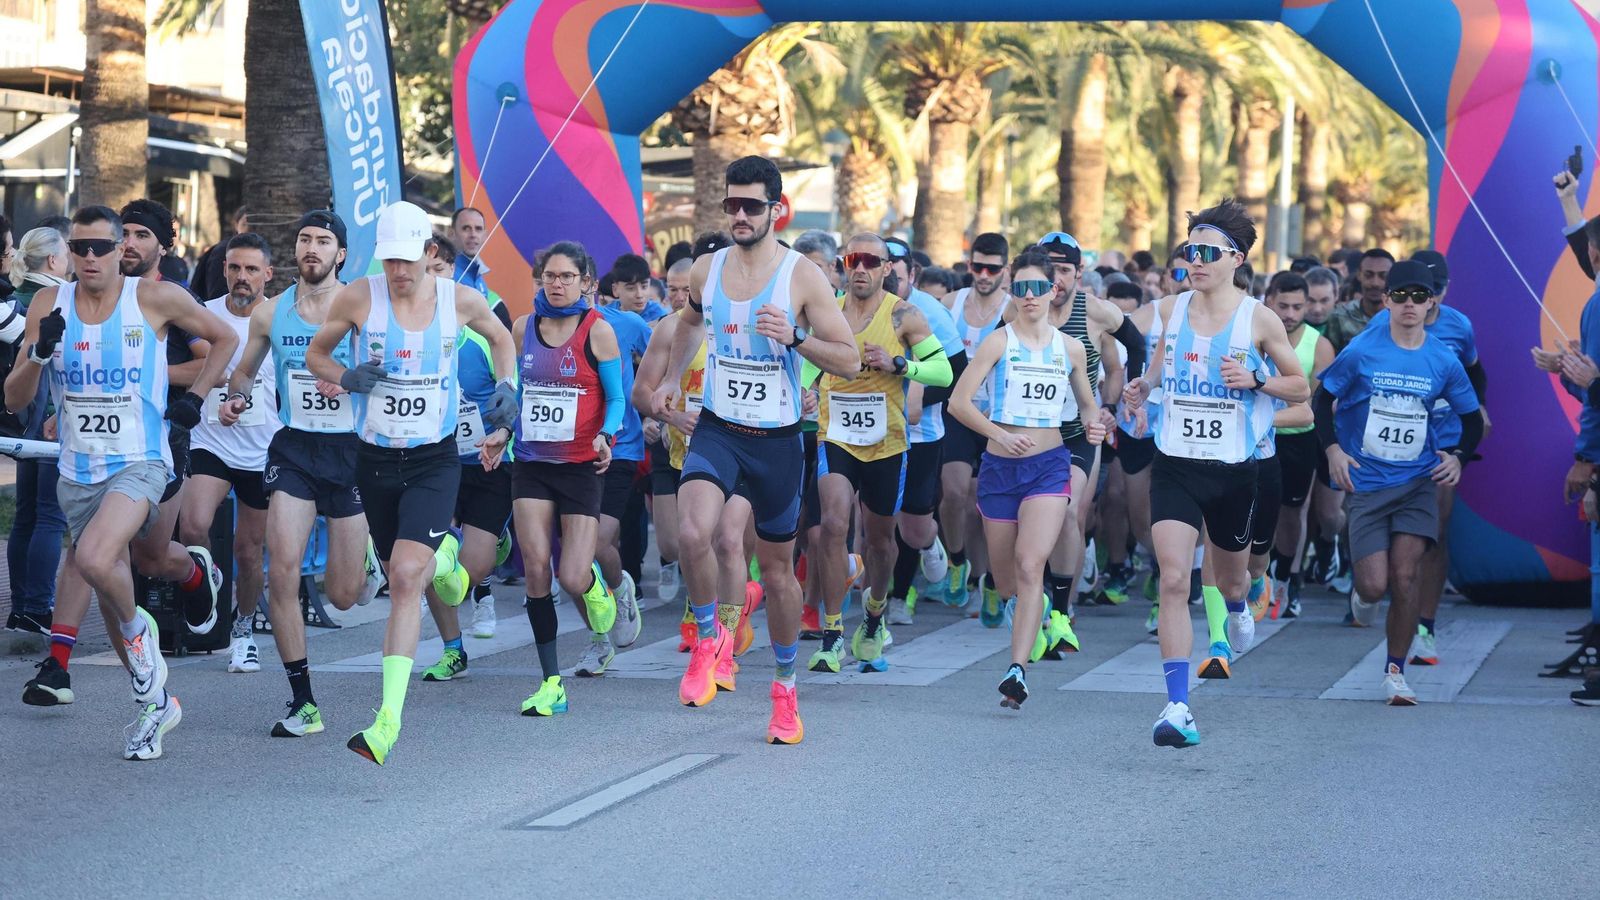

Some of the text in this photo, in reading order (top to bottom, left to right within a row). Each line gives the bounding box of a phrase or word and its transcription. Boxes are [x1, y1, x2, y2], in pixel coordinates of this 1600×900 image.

[727, 379, 767, 402] 573
[1022, 382, 1057, 401] 190
[1372, 376, 1403, 387] CIUDAD
[1404, 379, 1431, 391] JARDÍN
[302, 391, 340, 411] 536
[383, 395, 426, 417] 309
[529, 405, 564, 423] 590
[841, 411, 876, 428] 345
[78, 414, 121, 434] 220
[1182, 418, 1223, 439] 518
[1378, 426, 1415, 445] 416
